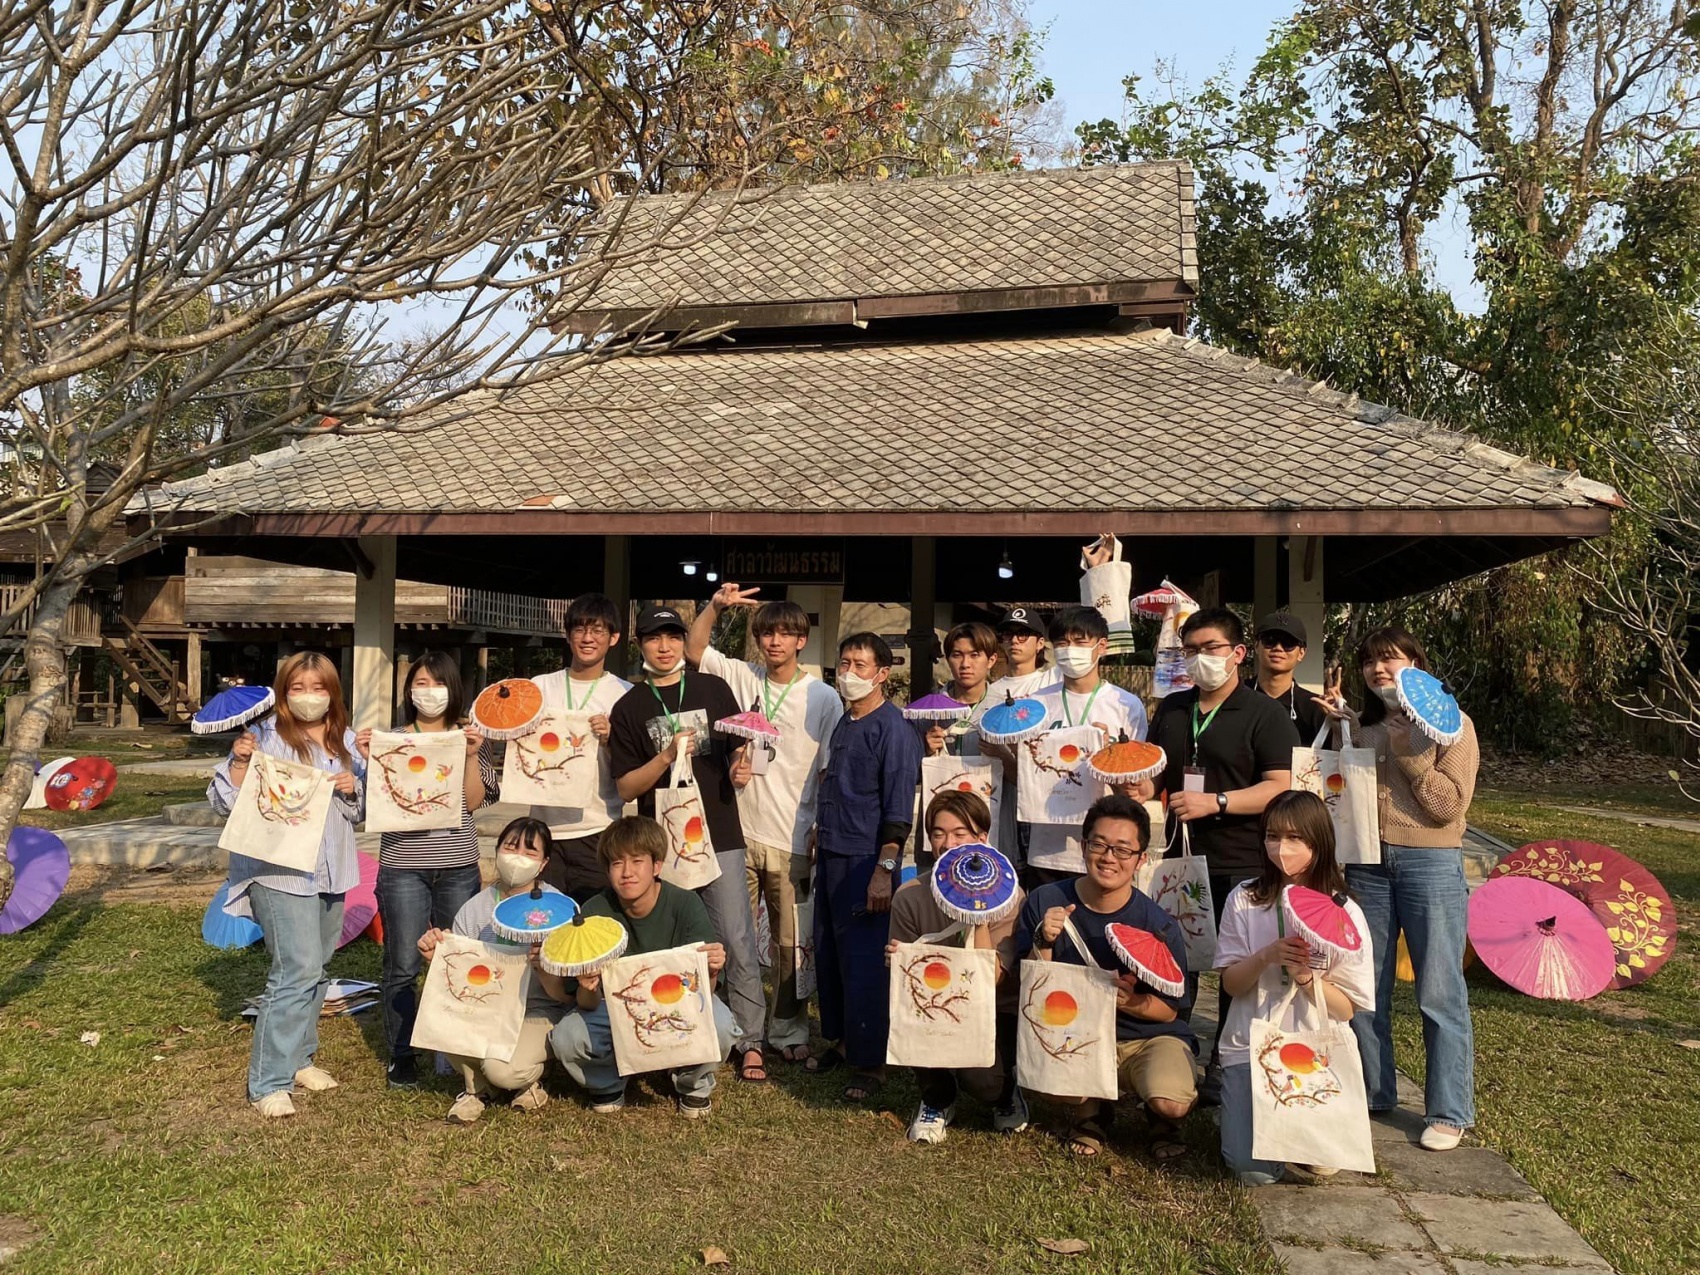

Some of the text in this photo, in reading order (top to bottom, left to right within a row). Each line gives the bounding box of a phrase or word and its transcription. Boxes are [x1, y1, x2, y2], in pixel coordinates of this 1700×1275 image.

[726, 542, 840, 574] ศาลาวัฒนธรรม
